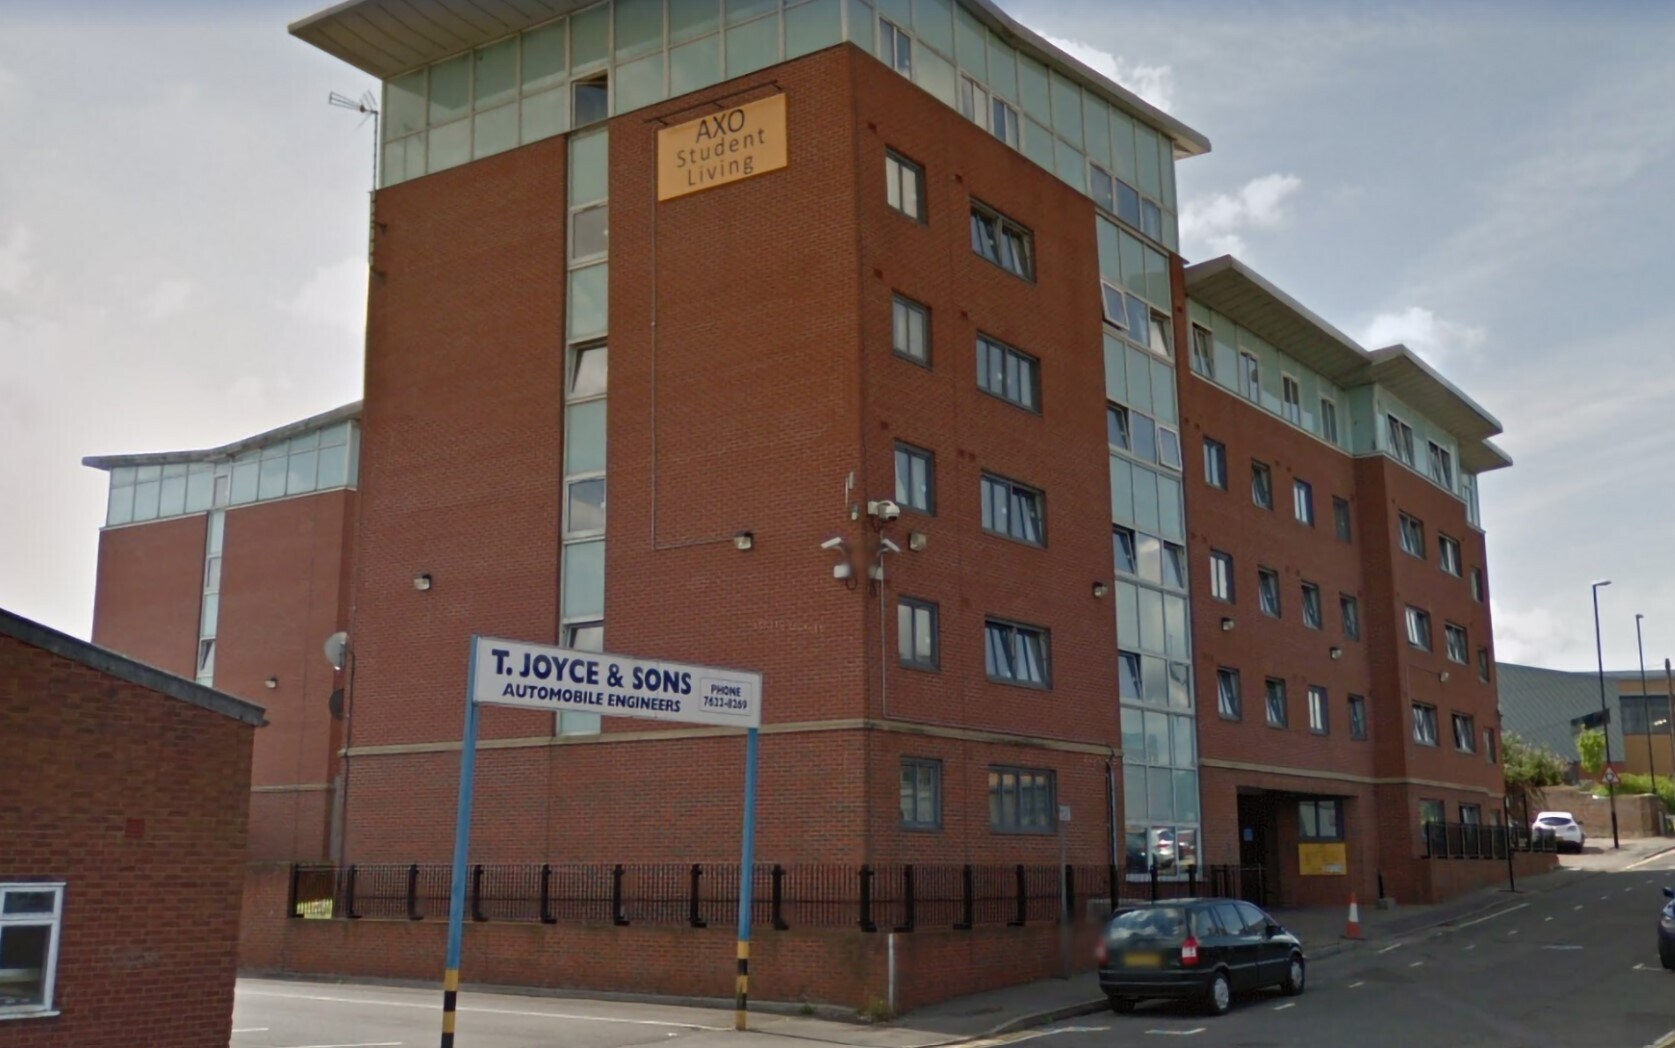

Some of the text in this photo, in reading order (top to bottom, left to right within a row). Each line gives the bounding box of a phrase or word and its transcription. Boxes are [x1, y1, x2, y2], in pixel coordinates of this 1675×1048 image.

[696, 108, 745, 143] AXO
[676, 128, 765, 168] Student
[688, 155, 754, 187] Living
[491, 648, 692, 695] T. JOYCE & SONS
[502, 683, 681, 712] AUTOMOBILE ENGINEERS
[710, 684, 742, 697] PHONE
